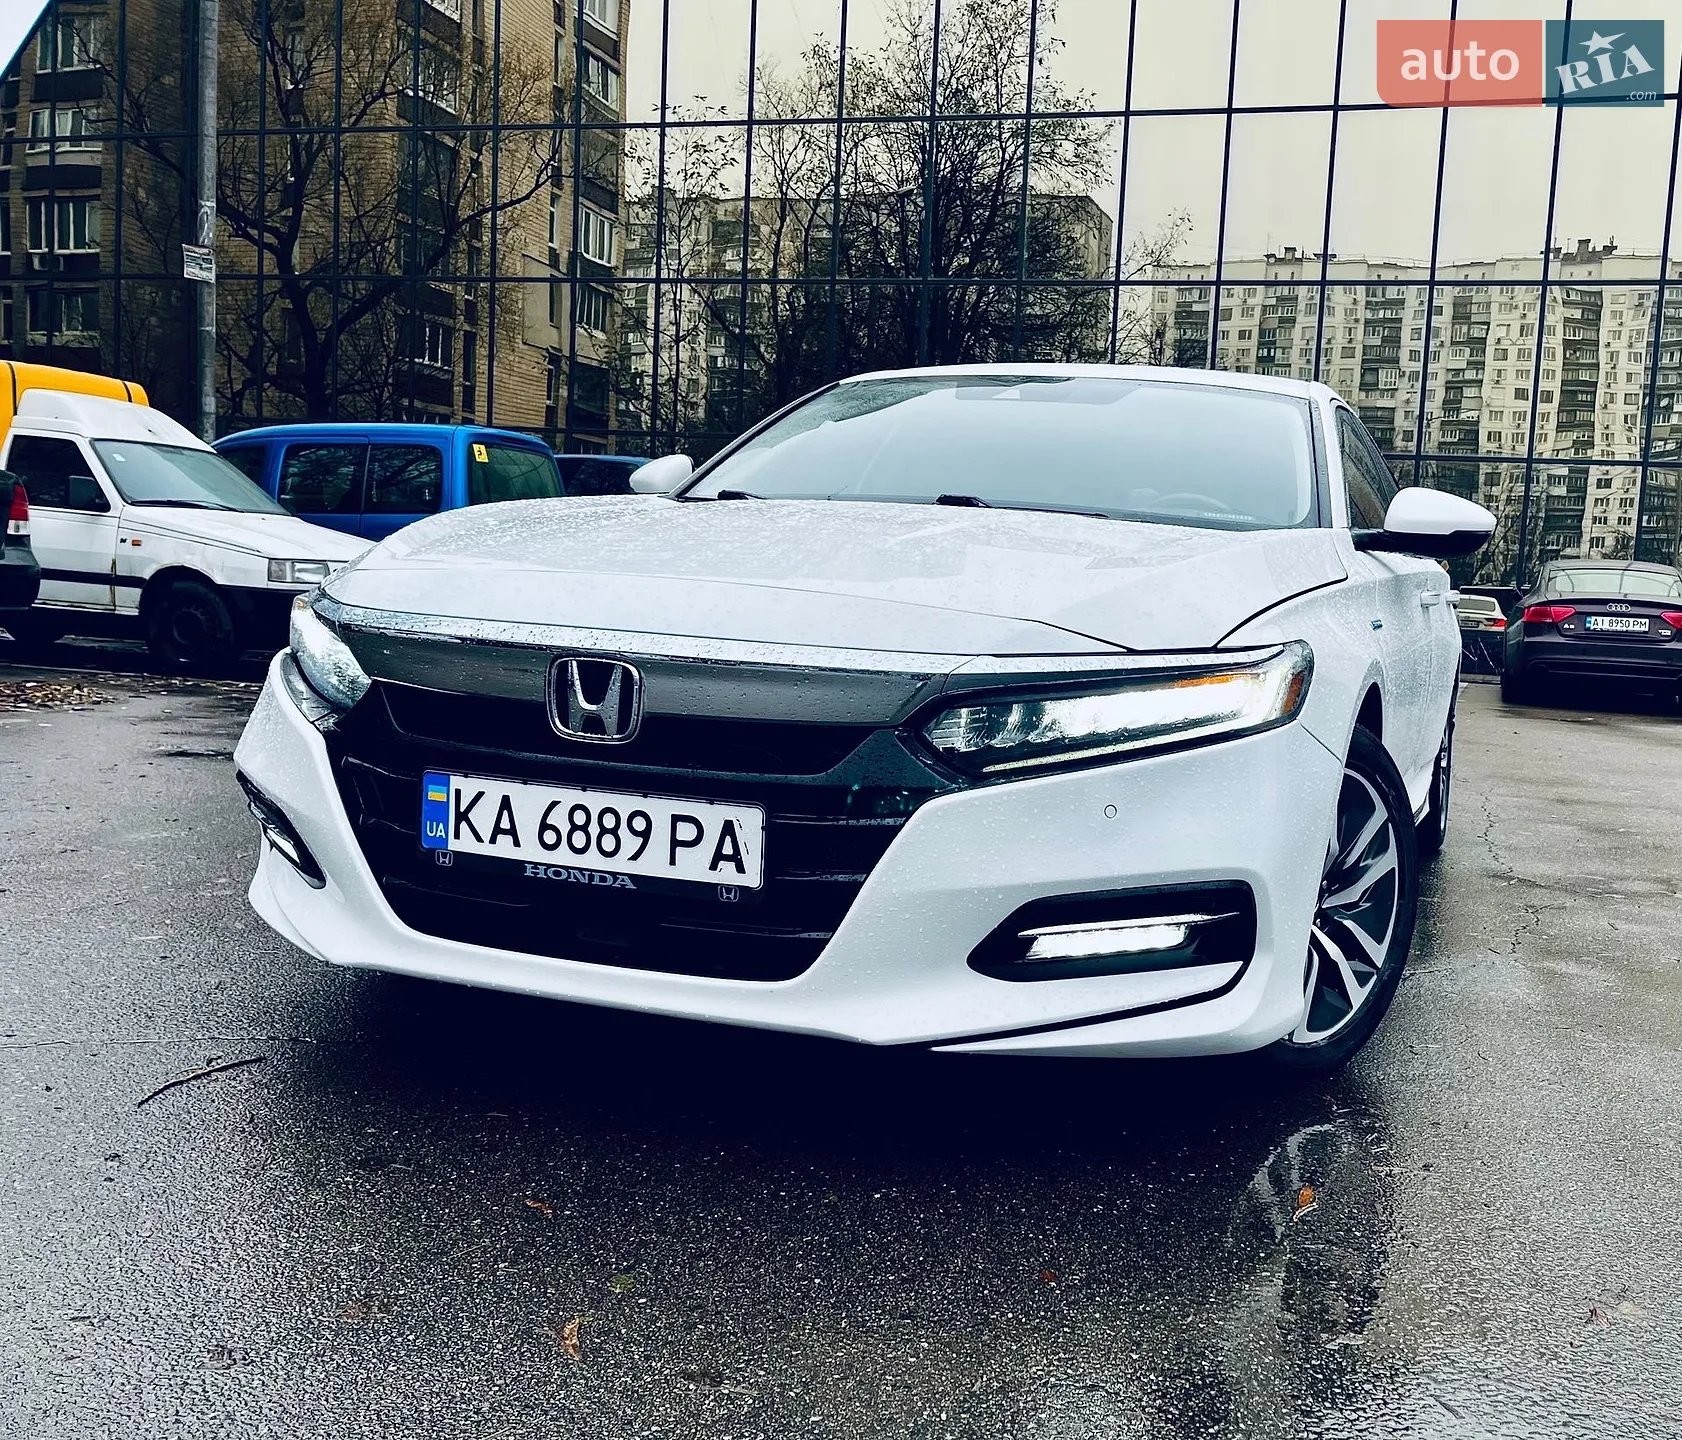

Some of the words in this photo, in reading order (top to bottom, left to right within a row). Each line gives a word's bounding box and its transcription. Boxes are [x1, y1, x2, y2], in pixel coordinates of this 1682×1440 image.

[1608, 618, 1630, 628] 8950
[1632, 620, 1647, 629] PM
[426, 820, 446, 839] UA
[453, 787, 522, 848] KA
[537, 799, 652, 862] 6889
[668, 813, 748, 875] PA
[524, 863, 637, 889] HONDA
